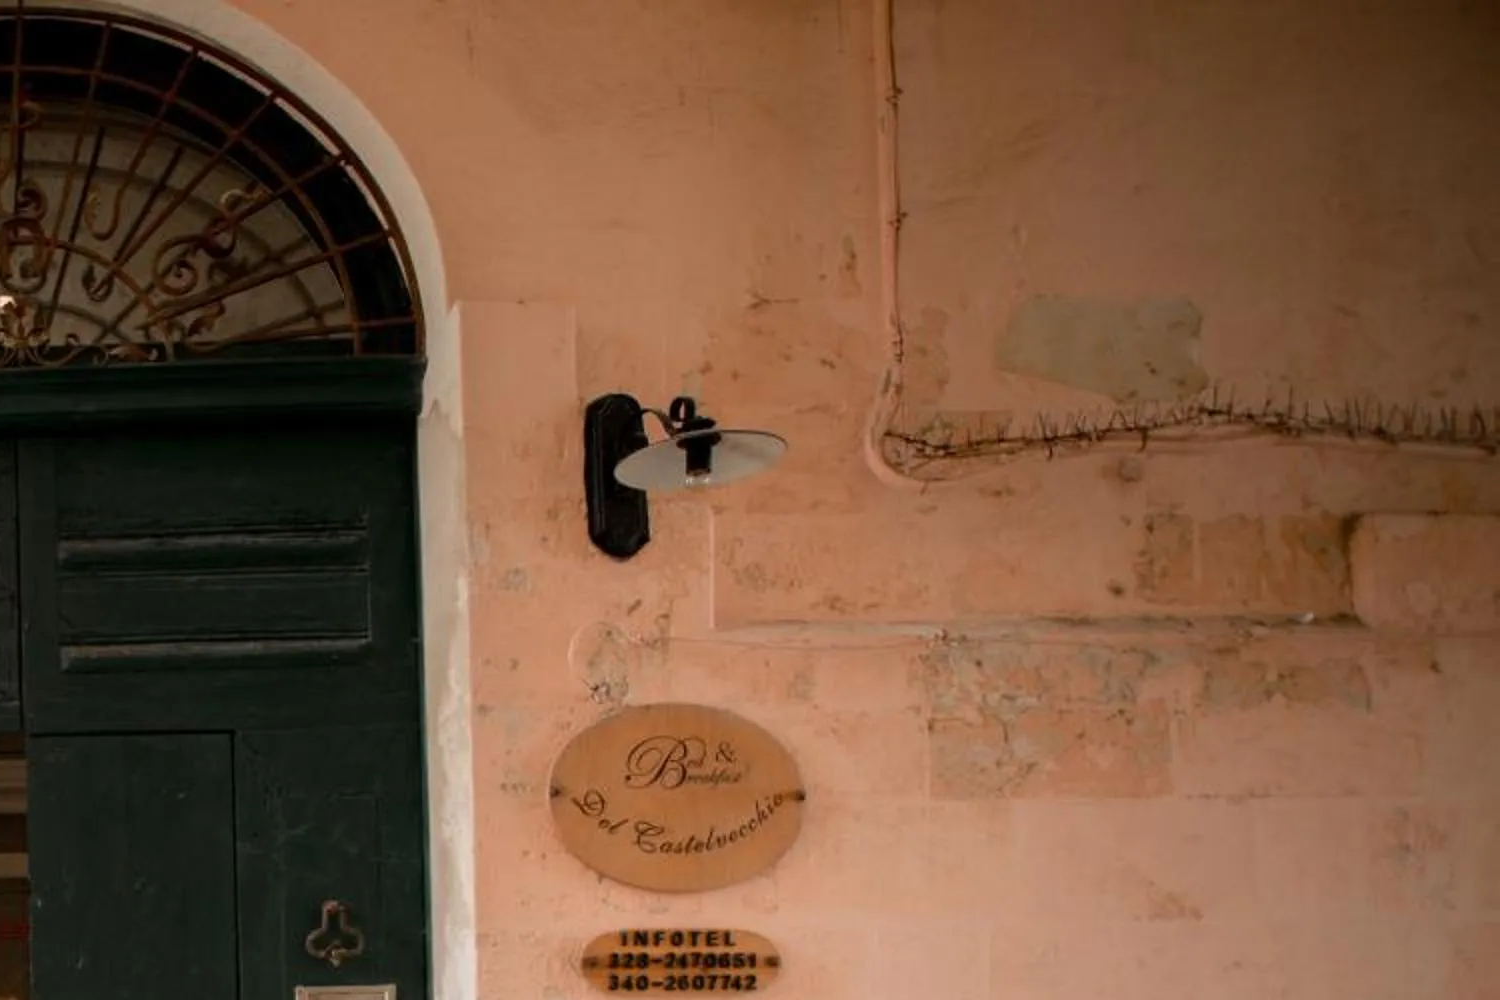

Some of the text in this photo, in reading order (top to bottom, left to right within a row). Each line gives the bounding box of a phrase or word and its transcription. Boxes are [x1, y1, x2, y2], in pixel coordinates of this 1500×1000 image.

[715, 741, 737, 763] &
[571, 789, 784, 854] Del Castelvecchio
[619, 930, 736, 947] INFOTEL
